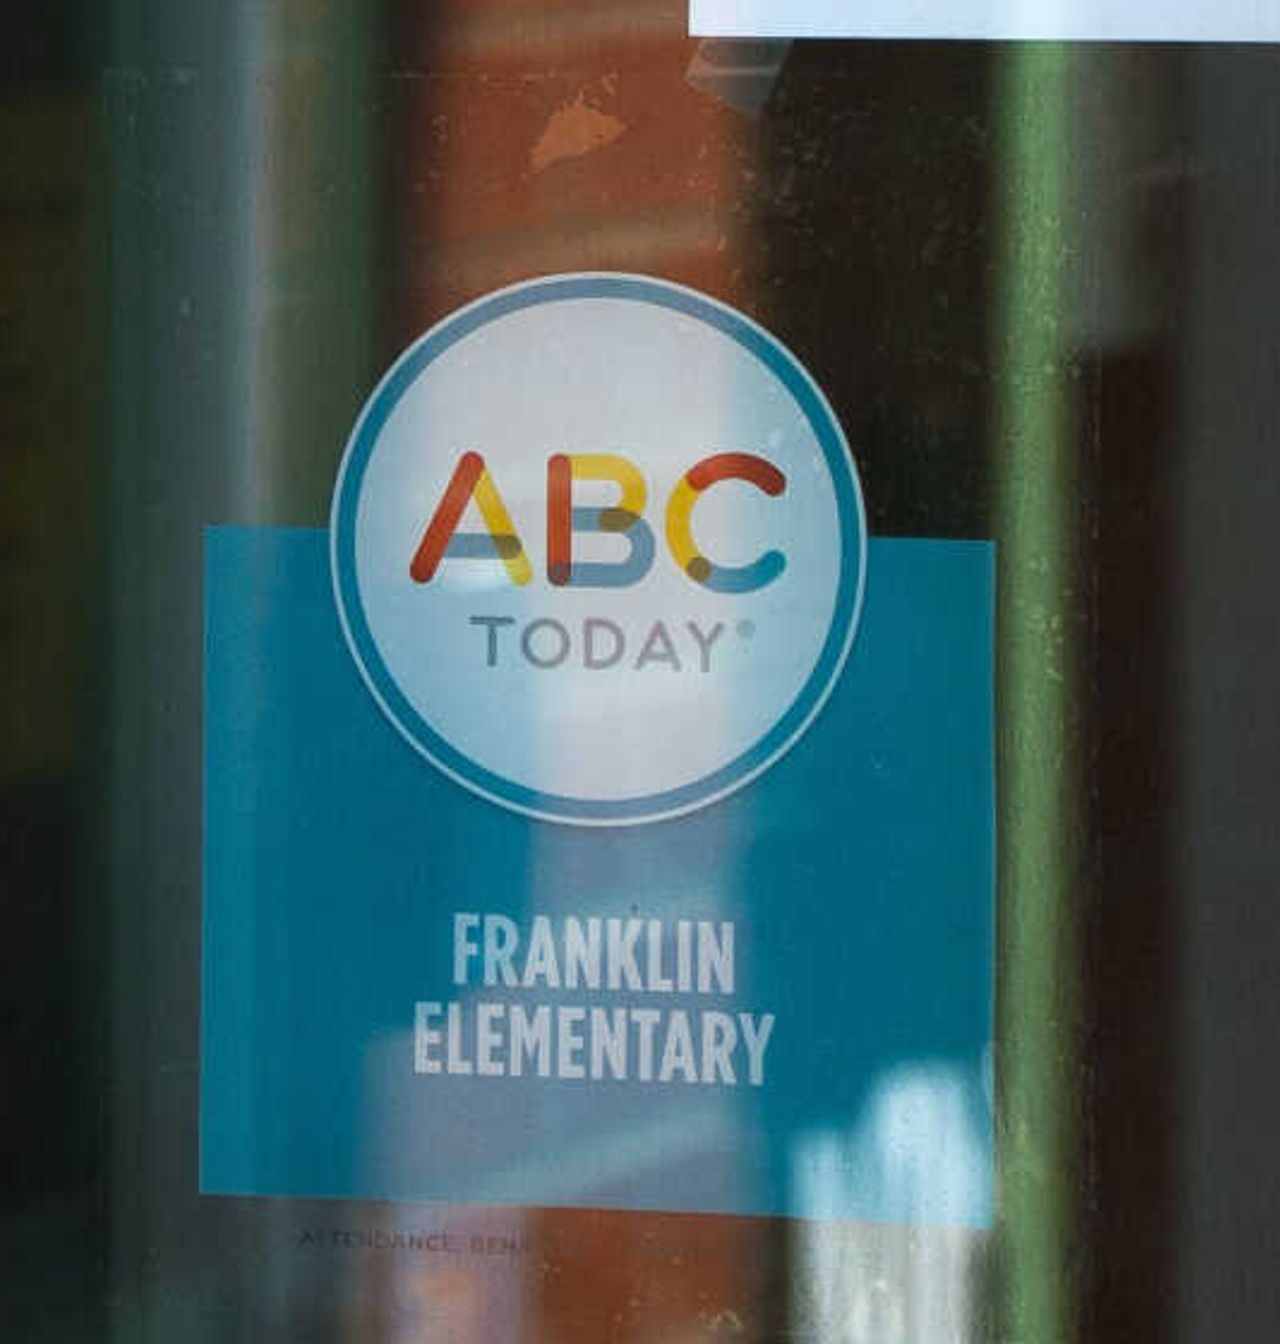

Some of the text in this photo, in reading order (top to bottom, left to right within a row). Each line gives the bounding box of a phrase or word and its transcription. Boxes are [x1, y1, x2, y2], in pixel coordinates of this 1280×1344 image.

[409, 451, 787, 594] ABC
[453, 912, 735, 995] FRANKLIN
[413, 1001, 775, 1086] ELEMENTARY
